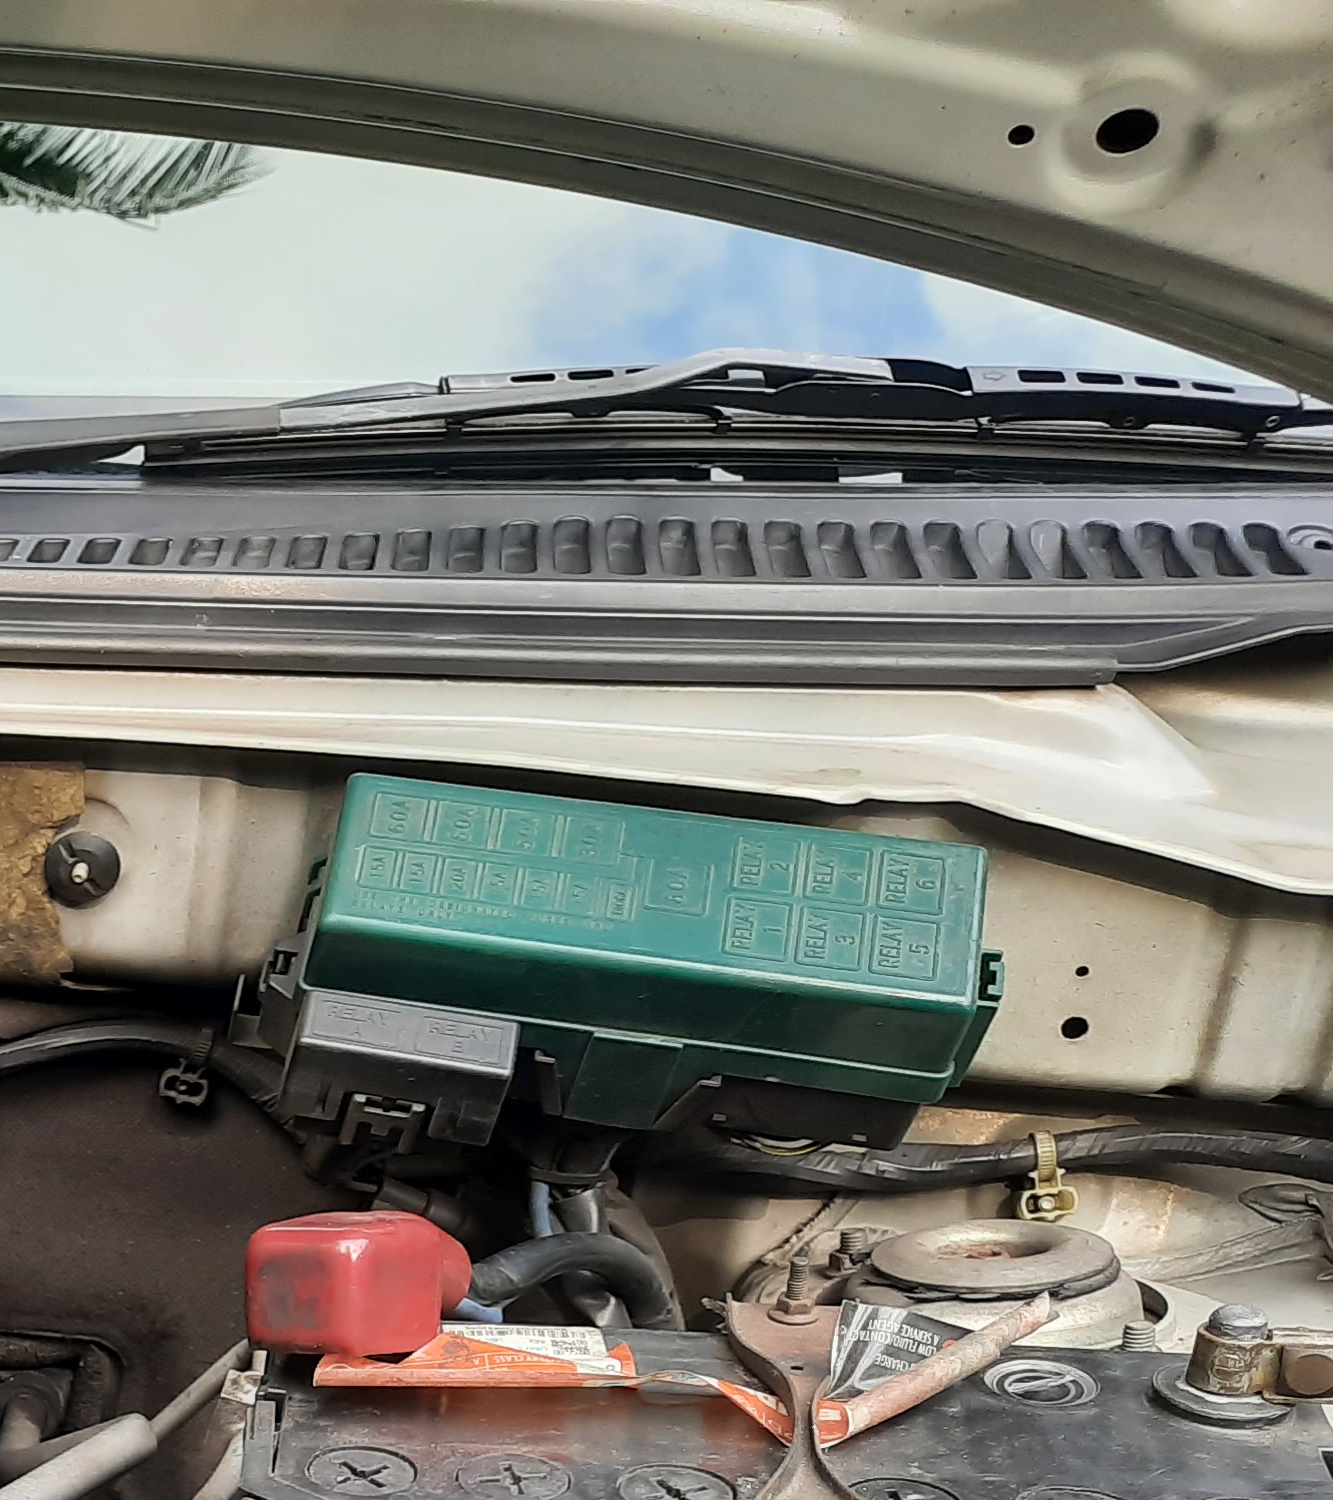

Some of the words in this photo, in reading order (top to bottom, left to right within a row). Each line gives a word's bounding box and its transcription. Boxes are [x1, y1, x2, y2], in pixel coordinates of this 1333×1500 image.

[769, 862, 791, 873] 2
[841, 869, 863, 882] 4
[885, 857, 911, 904] RELAY
[915, 877, 937, 891] 6
[731, 903, 757, 951] RELAY
[762, 926, 783, 935] 1
[804, 913, 830, 961] RELAY
[834, 935, 856, 947] 3
[878, 920, 904, 969] RELAY
[908, 943, 932, 957] 5
[428, 1021, 492, 1043] RELAY
[867, 1319, 900, 1333] AGENT
[900, 1324, 933, 1344] SERVICE
[917, 1343, 937, 1357] LOW
[874, 1353, 909, 1372] CHARGE
